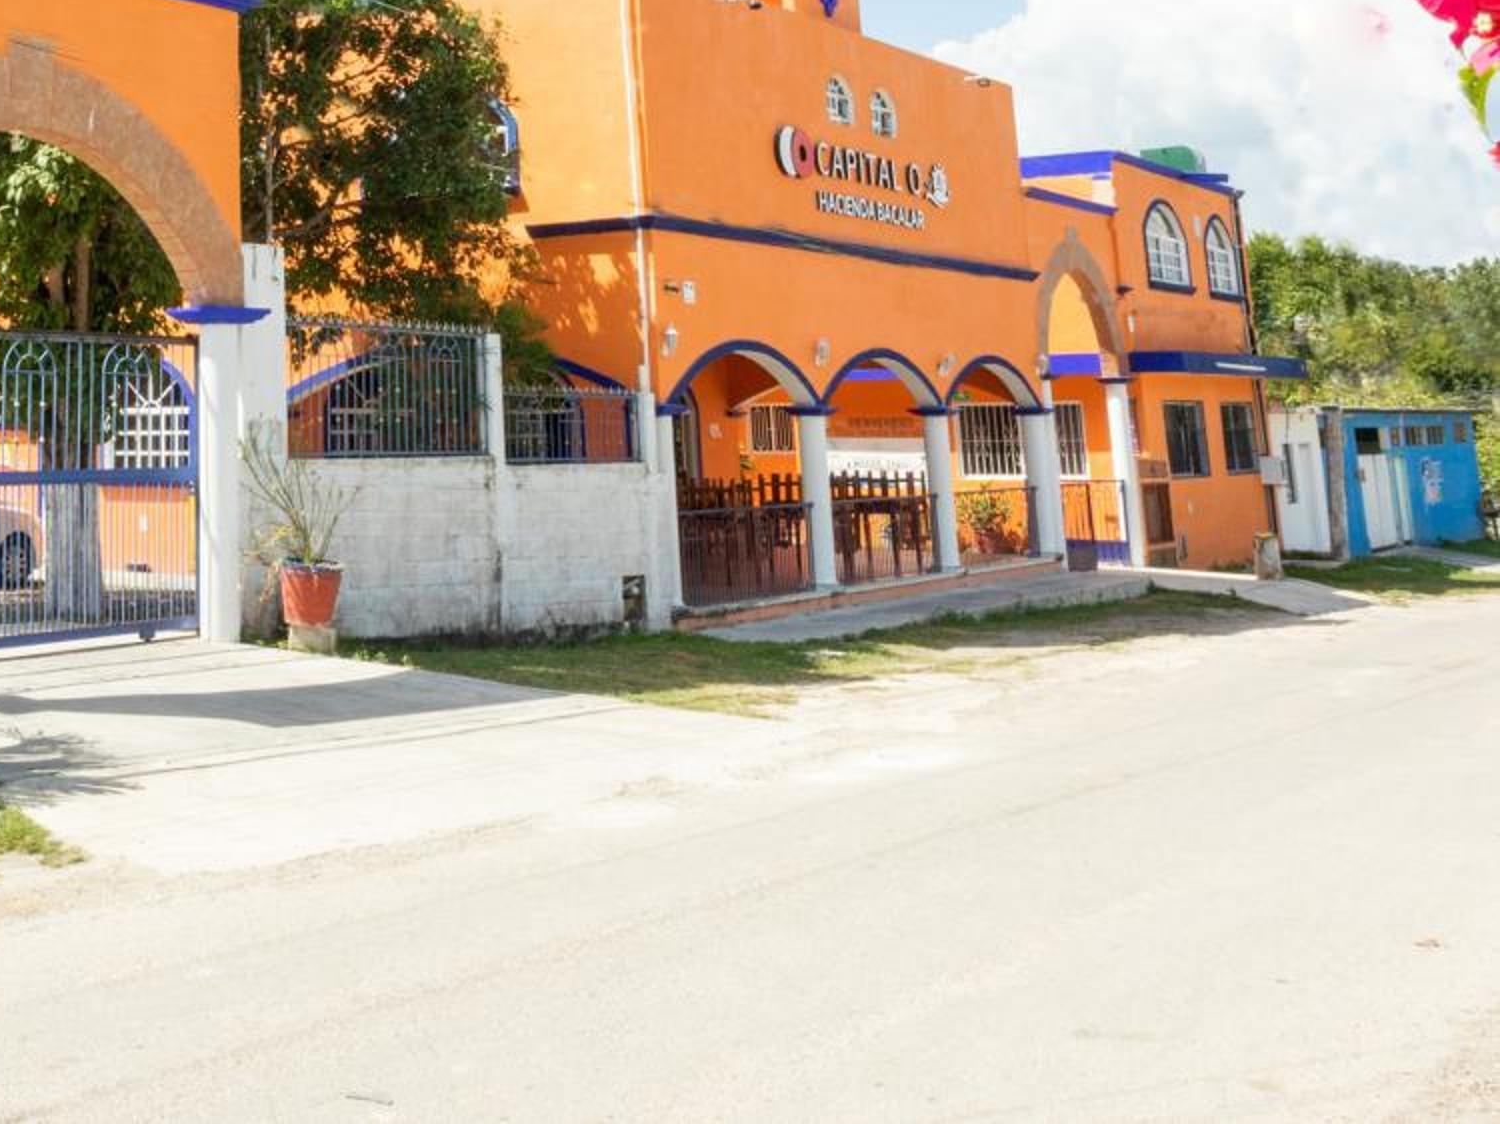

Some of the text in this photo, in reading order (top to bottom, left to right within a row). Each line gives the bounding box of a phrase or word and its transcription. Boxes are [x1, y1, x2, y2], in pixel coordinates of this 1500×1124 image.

[816, 142, 921, 196] CAPITAL O
[817, 190, 924, 230] HACIENDA BACALAR
